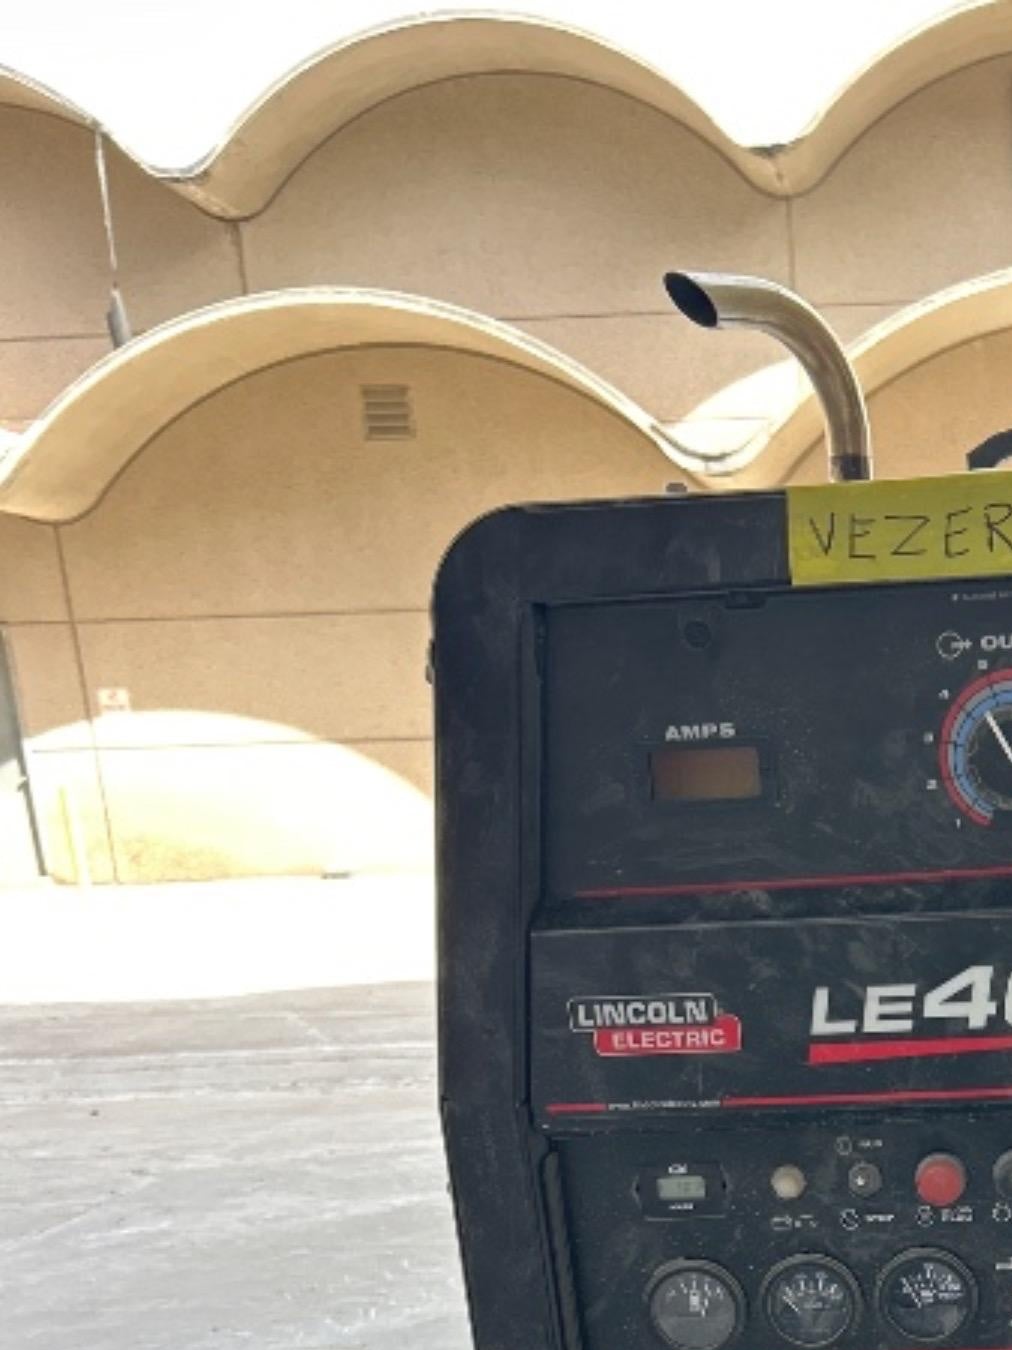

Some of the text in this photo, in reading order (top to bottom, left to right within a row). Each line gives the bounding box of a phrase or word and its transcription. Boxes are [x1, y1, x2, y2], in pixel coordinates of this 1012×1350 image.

[665, 723, 735, 742] AMPS
[577, 999, 709, 1027] LINCOLN
[612, 1029, 727, 1050] ELECTRIC
